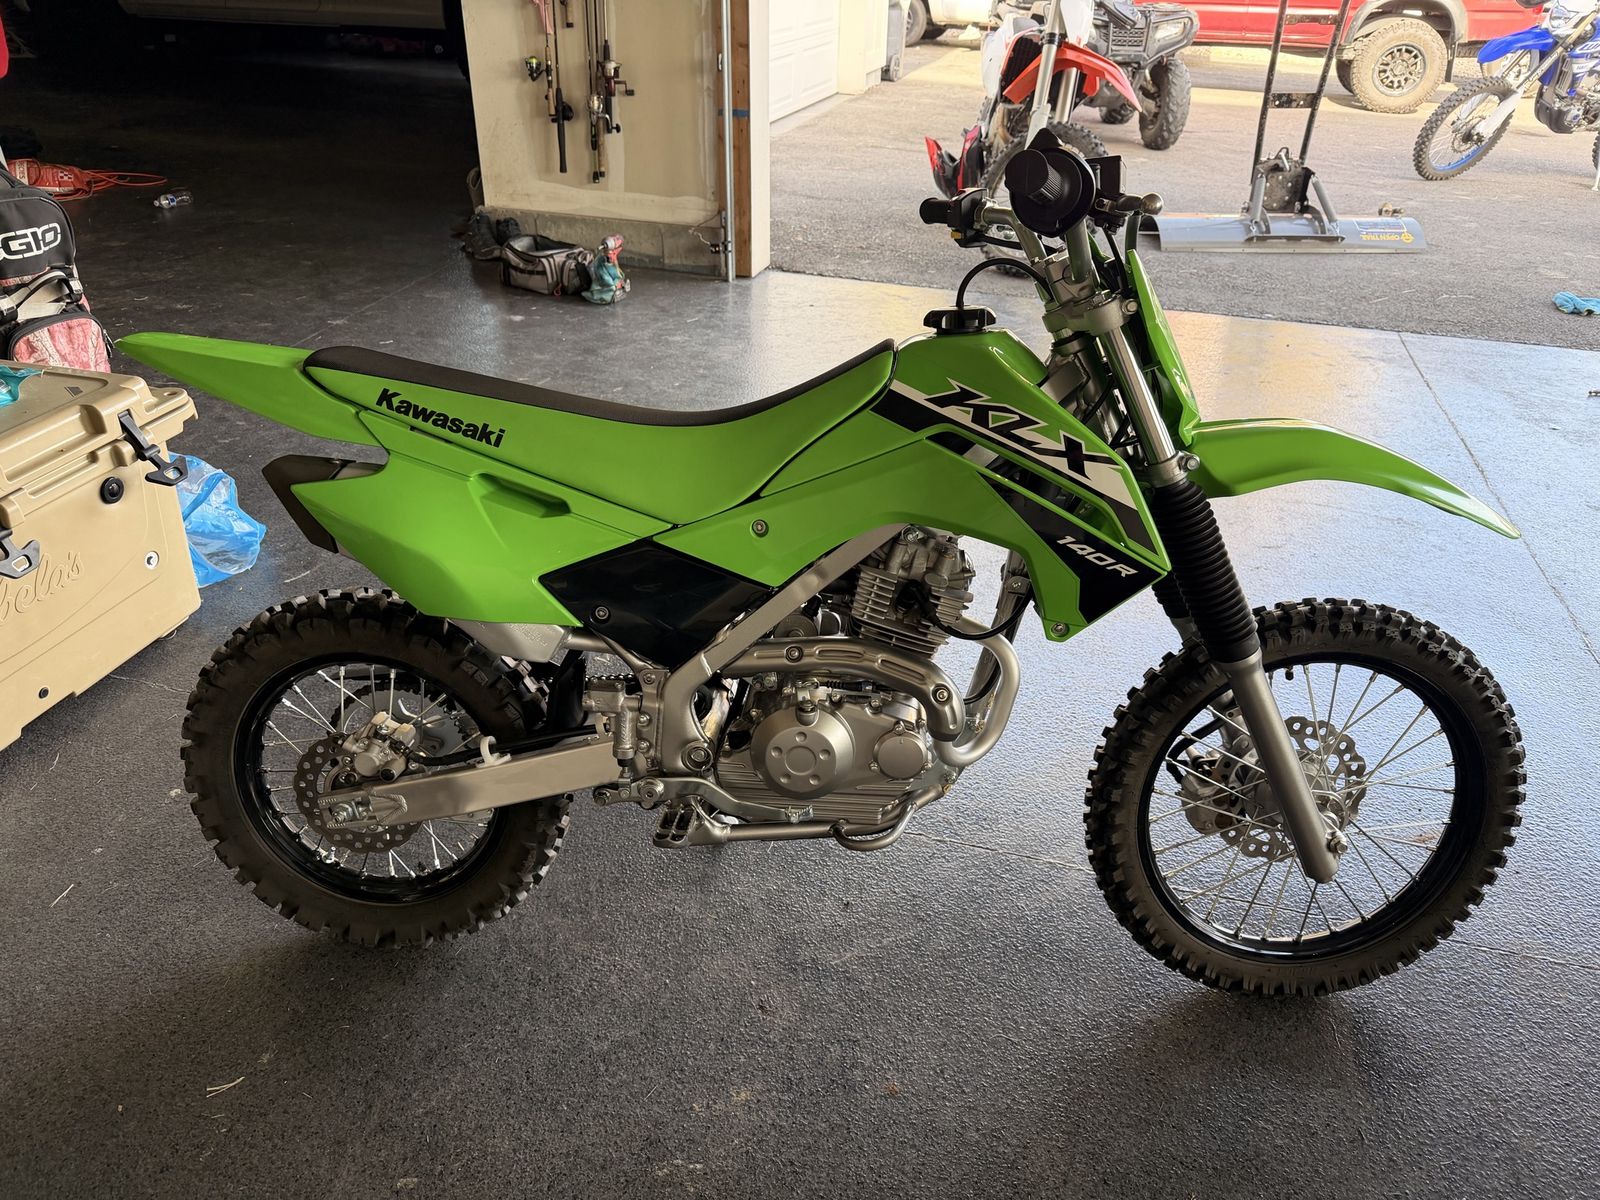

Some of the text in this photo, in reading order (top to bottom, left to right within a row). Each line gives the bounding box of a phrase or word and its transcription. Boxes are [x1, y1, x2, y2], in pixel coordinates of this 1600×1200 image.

[0, 222, 61, 260] GIO
[375, 387, 506, 448] Kawasaki
[924, 382, 1123, 481] KLX
